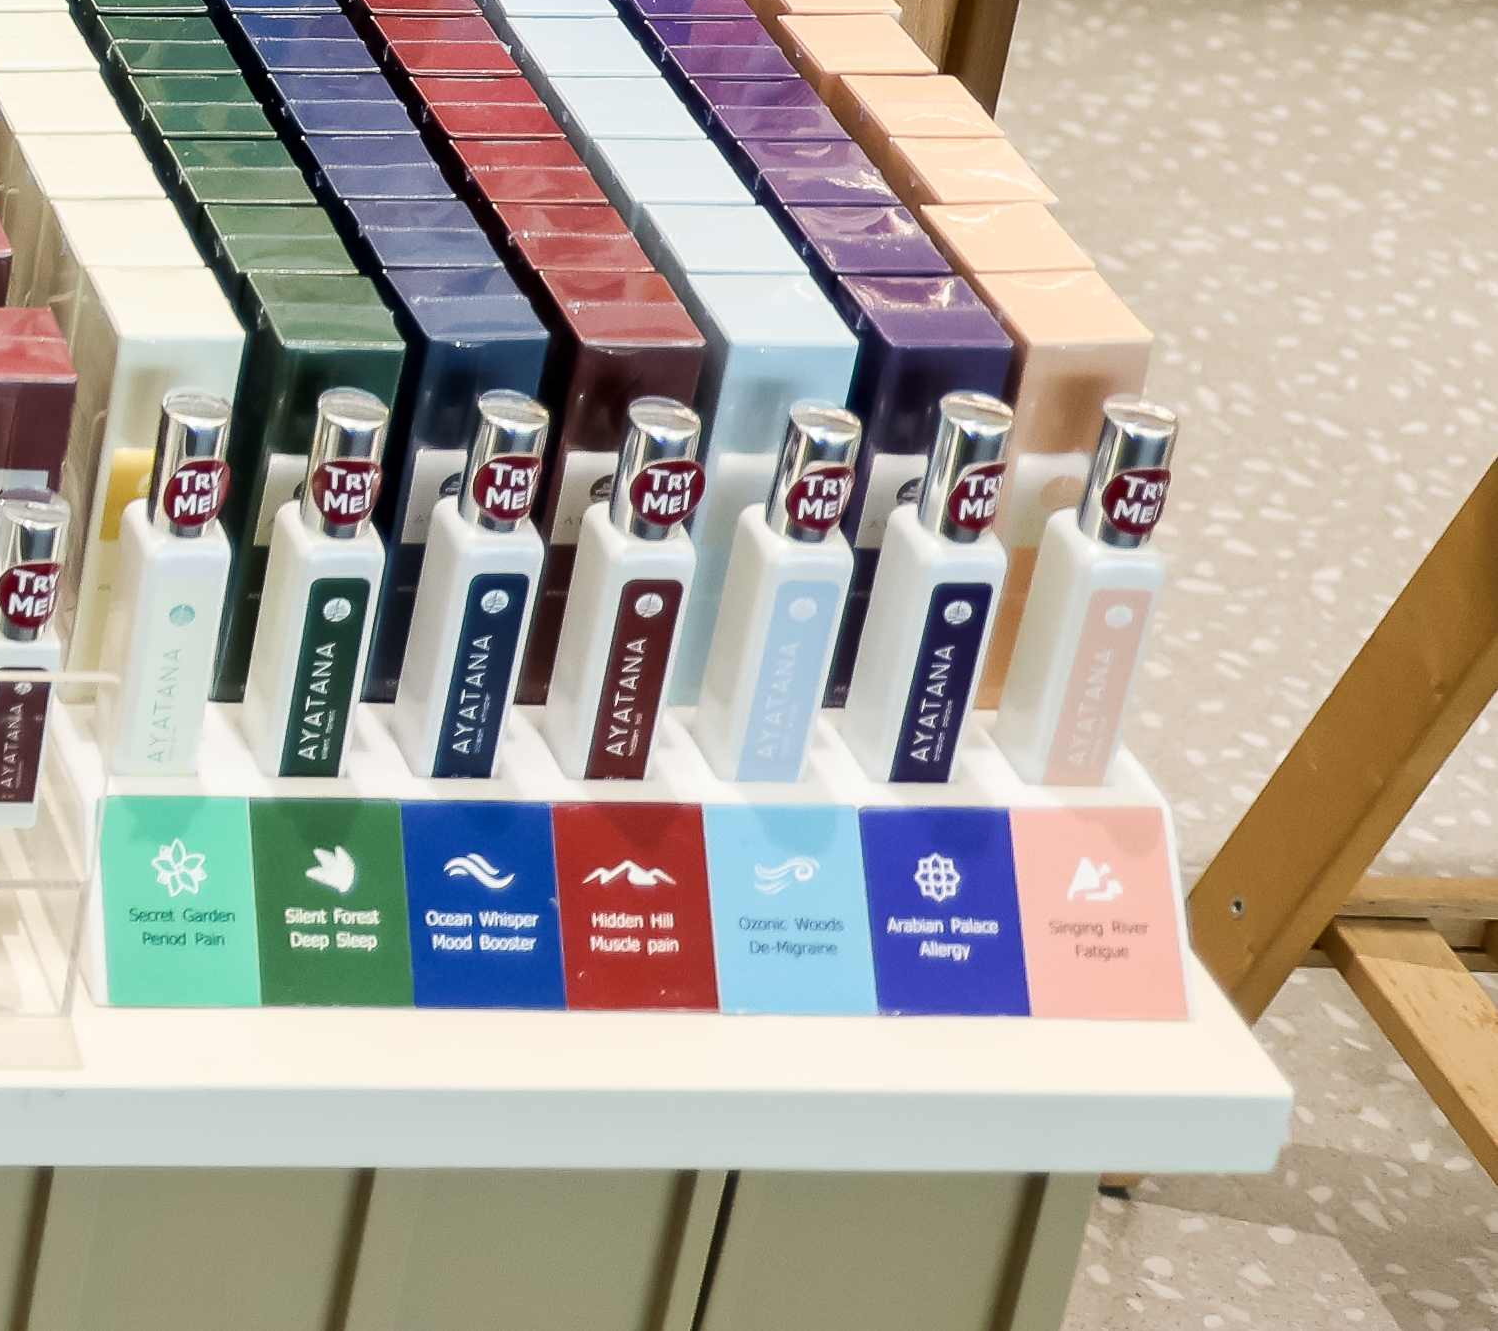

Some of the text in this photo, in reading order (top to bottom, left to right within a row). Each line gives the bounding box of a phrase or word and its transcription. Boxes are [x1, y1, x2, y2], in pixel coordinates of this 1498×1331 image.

[297, 640, 336, 761] AYATANA
[607, 636, 648, 757] AYATANA
[129, 908, 236, 922] Secret Garden
[285, 908, 380, 925] Silent Forest
[425, 910, 539, 930] Ocean Whisper
[591, 911, 674, 930] Hidden Hill
[739, 916, 844, 933] Ozonic Woods
[887, 916, 999, 936] Arabian Palace
[1049, 920, 1149, 938] Singing River
[290, 932, 378, 952] Deep Sleep
[919, 940, 971, 961] Allergy
[1075, 943, 1129, 961] Fatigue
